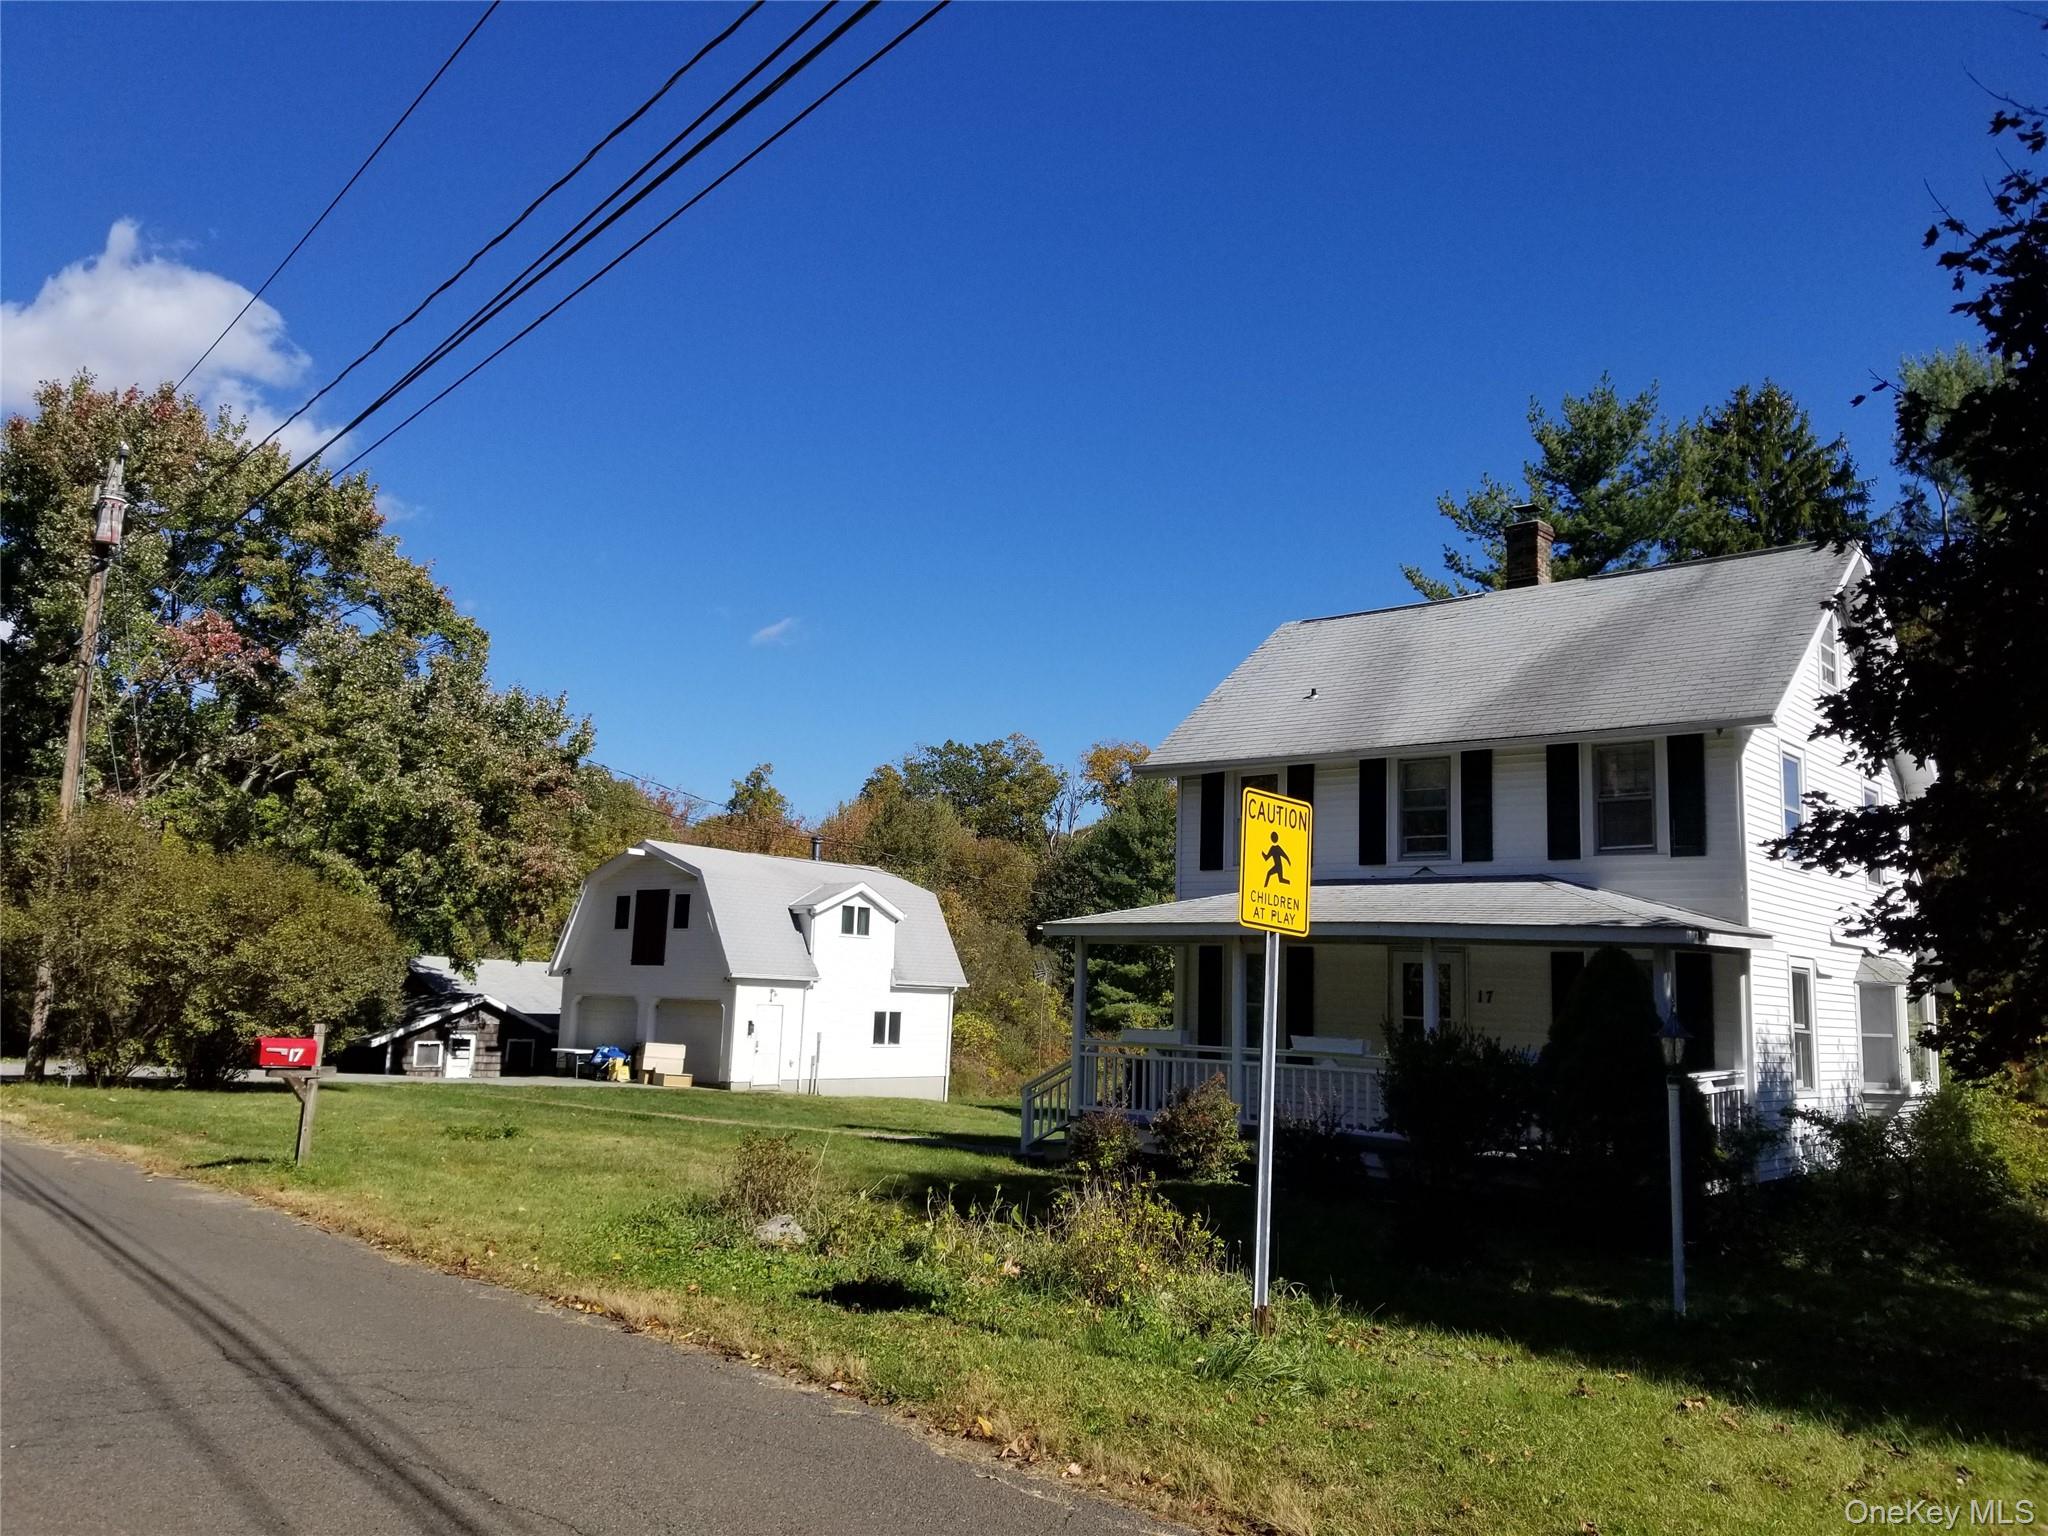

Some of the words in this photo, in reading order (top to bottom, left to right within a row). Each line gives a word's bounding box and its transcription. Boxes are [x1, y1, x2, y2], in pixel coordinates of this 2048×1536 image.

[1248, 798, 1307, 832] CAUTION
[1250, 890, 1300, 911] CHILDREN
[1253, 907, 1265, 920] AT
[1271, 910, 1296, 926] PLAY
[1478, 990, 1495, 1004] 17
[288, 1047, 304, 1062] 17
